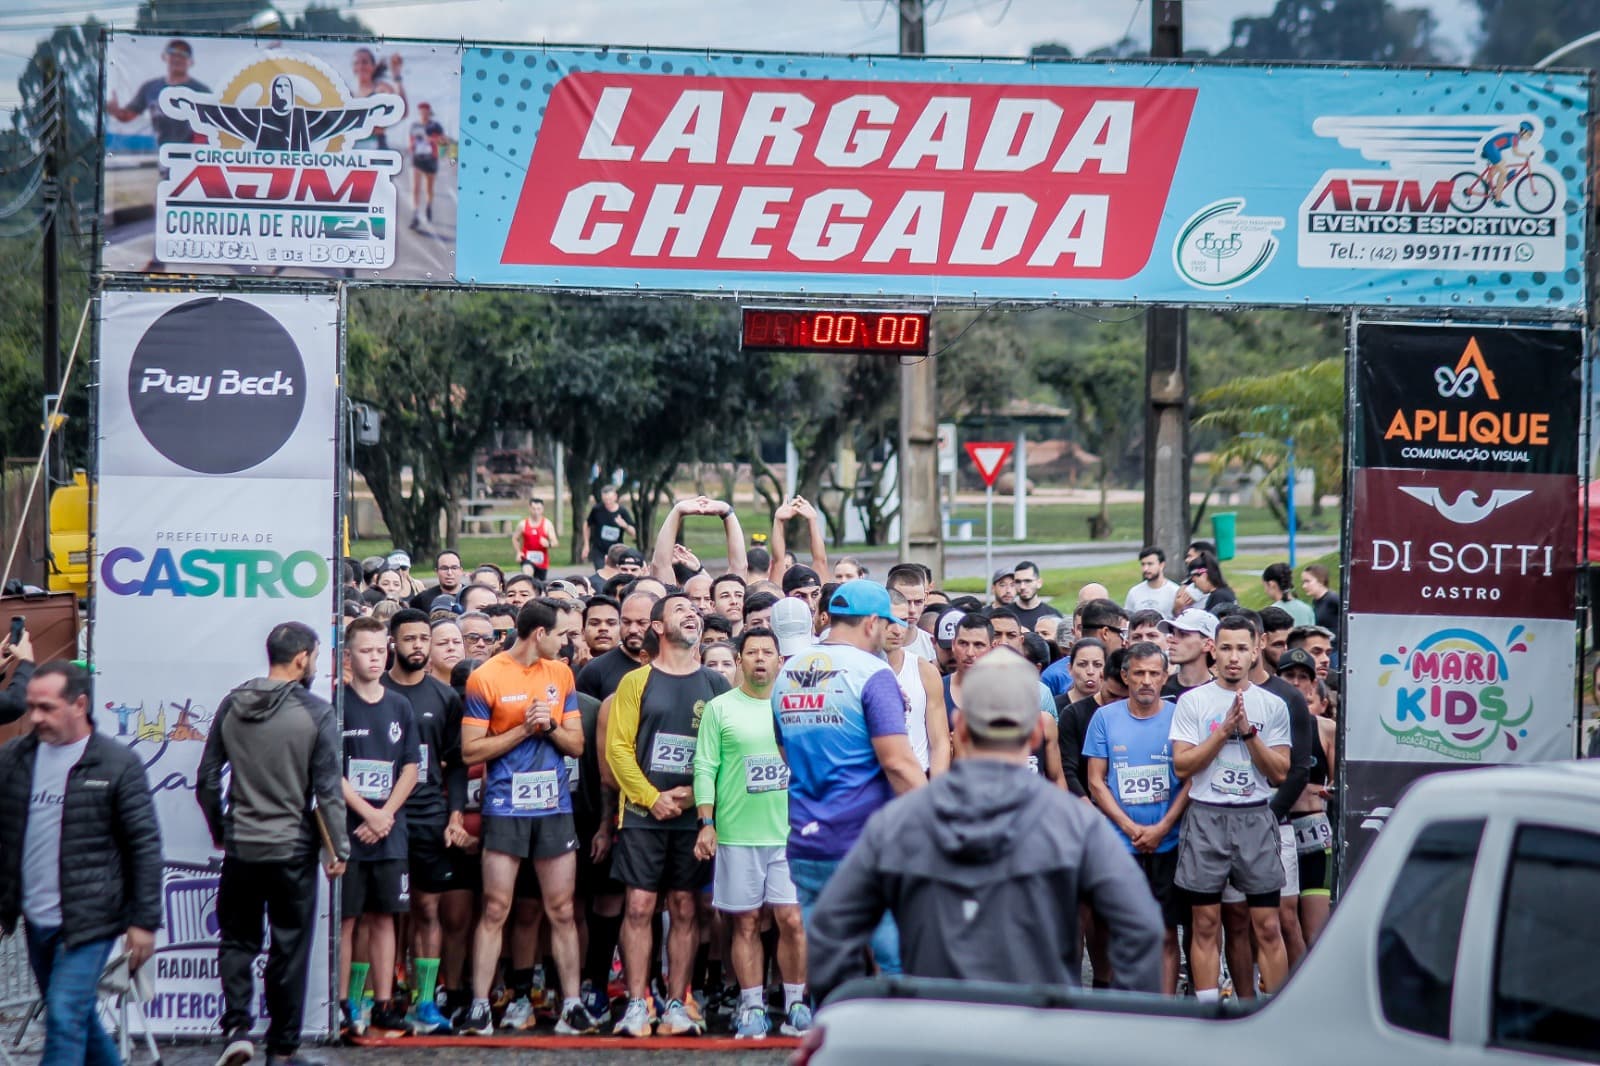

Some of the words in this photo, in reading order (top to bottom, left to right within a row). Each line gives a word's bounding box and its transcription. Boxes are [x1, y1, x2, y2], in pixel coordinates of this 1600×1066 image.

[578, 87, 1135, 174] LARGADA
[195, 150, 275, 164] CIRCUITO
[280, 151, 367, 167] REGIONAL
[170, 165, 378, 204] AJM
[1310, 179, 1456, 213] AJM
[371, 206, 385, 214] DE
[166, 210, 251, 236] CORRIDA
[259, 214, 283, 237] DE
[291, 215, 327, 239] RUA
[549, 181, 1110, 268] CHEGADA
[1312, 216, 1412, 234] EVENTOS
[1416, 217, 1551, 236] ESPORTIVOS
[167, 239, 258, 261] NUNCA
[282, 250, 303, 261] DE
[309, 243, 386, 265] BOA!
[1329, 242, 1364, 259] Tel.:
[1369, 246, 1397, 262] (42)
[1402, 243, 1512, 262] 99911-1111
[139, 367, 212, 401] Play
[218, 369, 294, 396] Beck
[1384, 407, 1550, 446] APLIQUE
[1400, 446, 1490, 463] COMUNICAÇÃO
[1491, 450, 1531, 463] VISUAL
[156, 531, 249, 544] PREFEITURA
[255, 533, 273, 544] DE
[1371, 539, 1413, 572] DI
[1427, 541, 1553, 577] SOTTI
[100, 546, 330, 599] CASTRO
[1420, 585, 1501, 601] CASTRO
[1411, 651, 1498, 683] MARI
[1396, 685, 1508, 725] KIDS
[657, 745, 696, 763] 257
[356, 772, 389, 788] 128
[750, 764, 788, 781] 282
[1222, 770, 1249, 786] 35
[518, 782, 554, 799] 211
[1123, 776, 1165, 794] 295
[1296, 823, 1330, 844] 119
